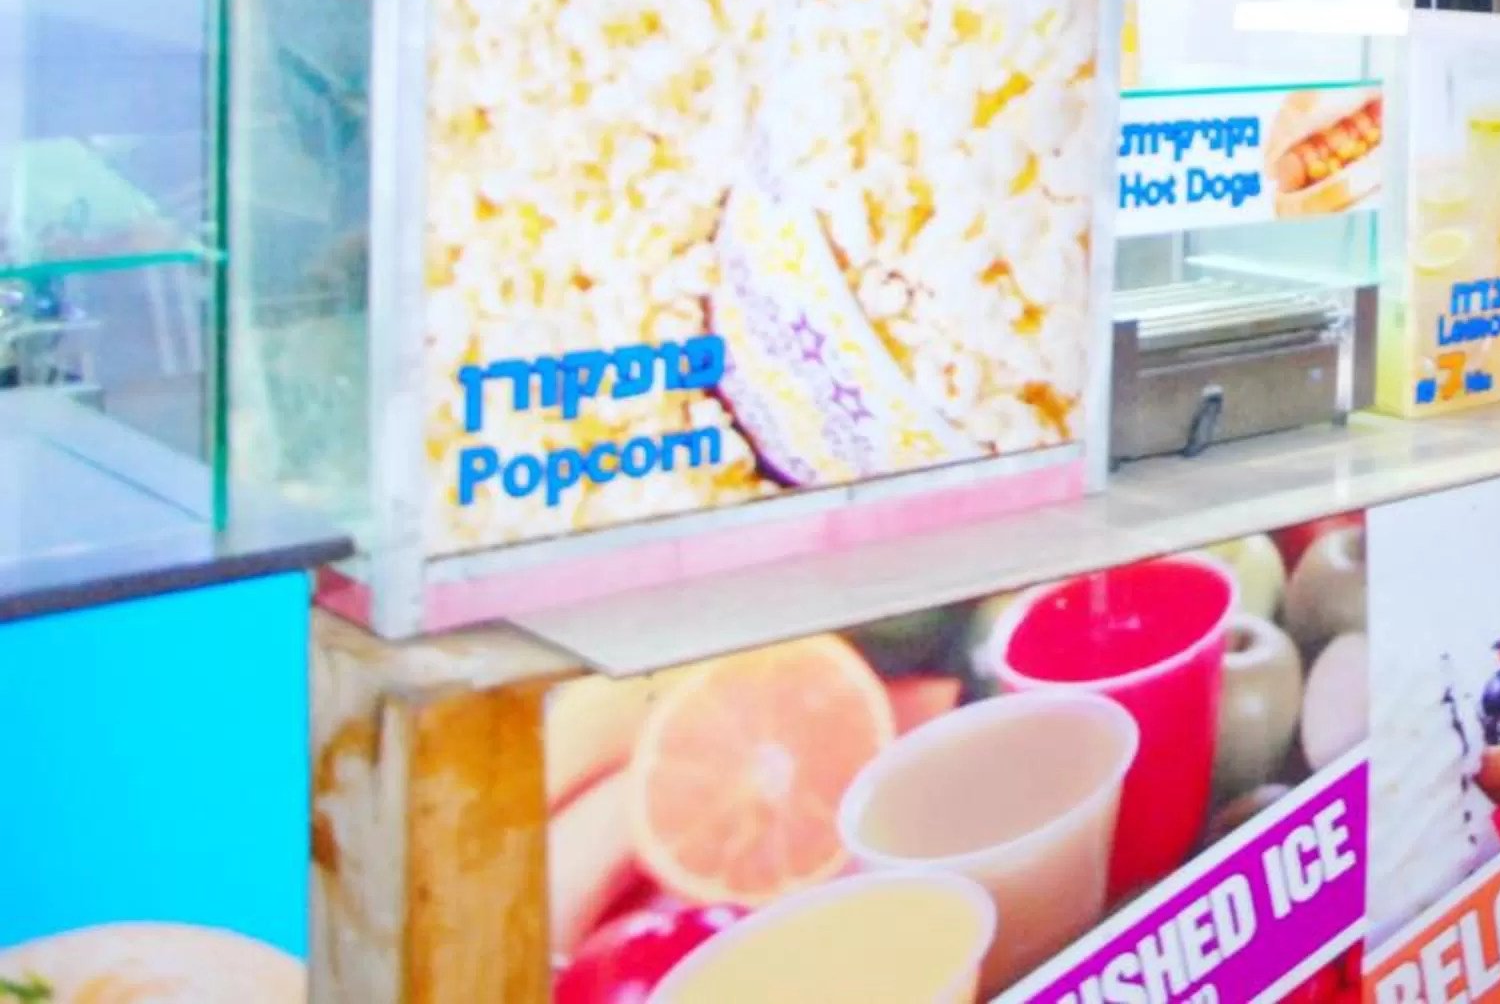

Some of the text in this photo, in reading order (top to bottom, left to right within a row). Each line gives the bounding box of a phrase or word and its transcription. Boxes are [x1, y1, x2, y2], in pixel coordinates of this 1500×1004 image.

[1118, 116, 1259, 162] נקניקיות
[1119, 167, 1261, 209] Hot Dogs
[457, 334, 726, 433] פופקורן
[1437, 351, 1467, 401] 7
[459, 426, 721, 506] Popcorn
[1262, 797, 1357, 920] ICE
